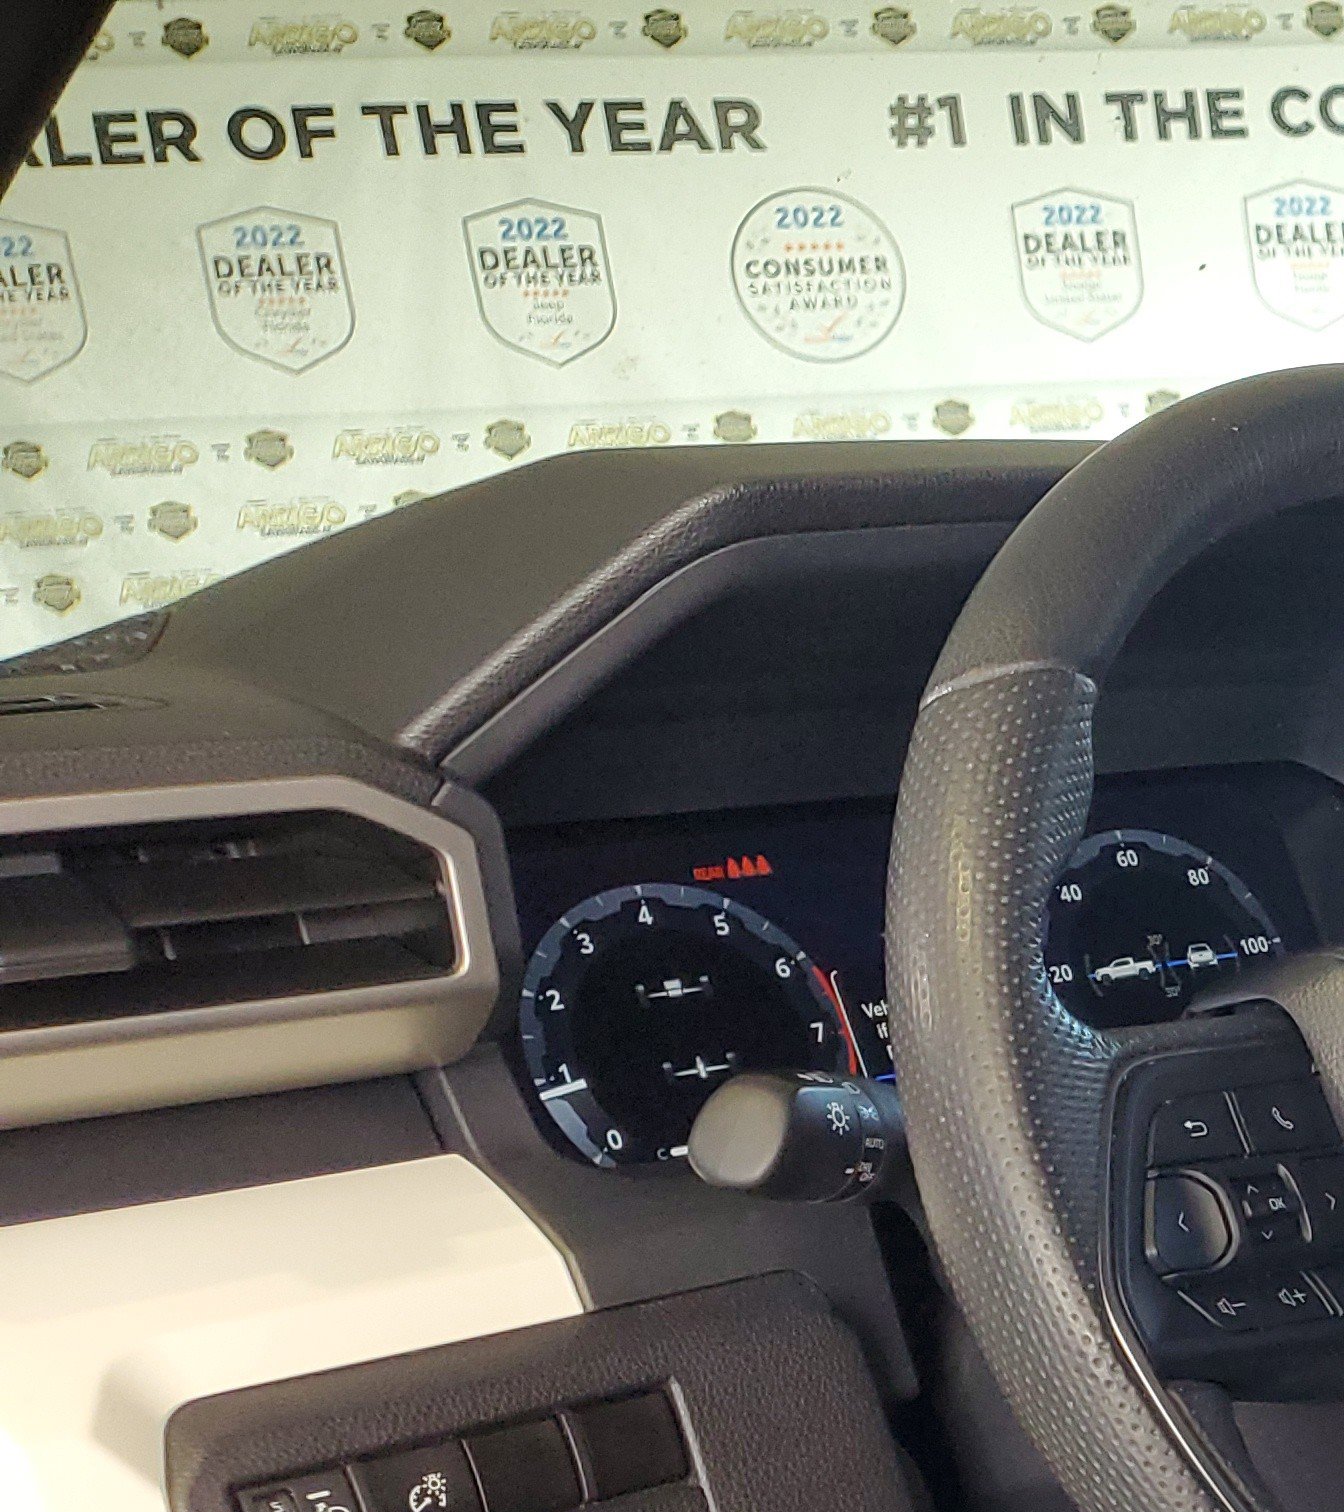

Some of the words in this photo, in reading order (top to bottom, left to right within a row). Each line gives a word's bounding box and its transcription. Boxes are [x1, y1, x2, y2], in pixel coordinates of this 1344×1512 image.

[227, 105, 336, 161] OF
[361, 100, 525, 157] THE
[545, 97, 768, 154] YEAR
[889, 93, 967, 149] #1
[1007, 91, 1085, 146] IN
[1105, 88, 1250, 142] THE
[775, 205, 845, 229] 2022
[1042, 204, 1102, 226] 2022
[1274, 195, 1332, 217] 2022
[233, 224, 305, 249] 2022
[499, 217, 568, 241] 2022
[1023, 229, 1129, 254] DEALER
[213, 253, 335, 281] DEALER
[478, 244, 599, 272] DEALER
[745, 255, 889, 279] CONSUMER
[217, 281, 245, 299] OF
[250, 279, 284, 297] THE
[291, 276, 341, 296] YEAR
[483, 271, 507, 289] OF
[514, 269, 550, 288] THE
[555, 267, 603, 287] YEAR
[788, 294, 859, 312] AWARD
[1116, 850, 1139, 868] 60
[1187, 868, 1210, 887] 80
[1059, 884, 1083, 903] 40
[638, 905, 654, 926] 4
[713, 912, 731, 936] 5
[576, 933, 595, 955] 3
[1239, 936, 1270, 955] 100
[775, 957, 792, 979] 6
[1050, 964, 1074, 984] 20
[549, 990, 565, 1012] 2
[809, 1022, 826, 1044] 7
[558, 1062, 572, 1084] 1
[605, 1129, 624, 1151] 0
